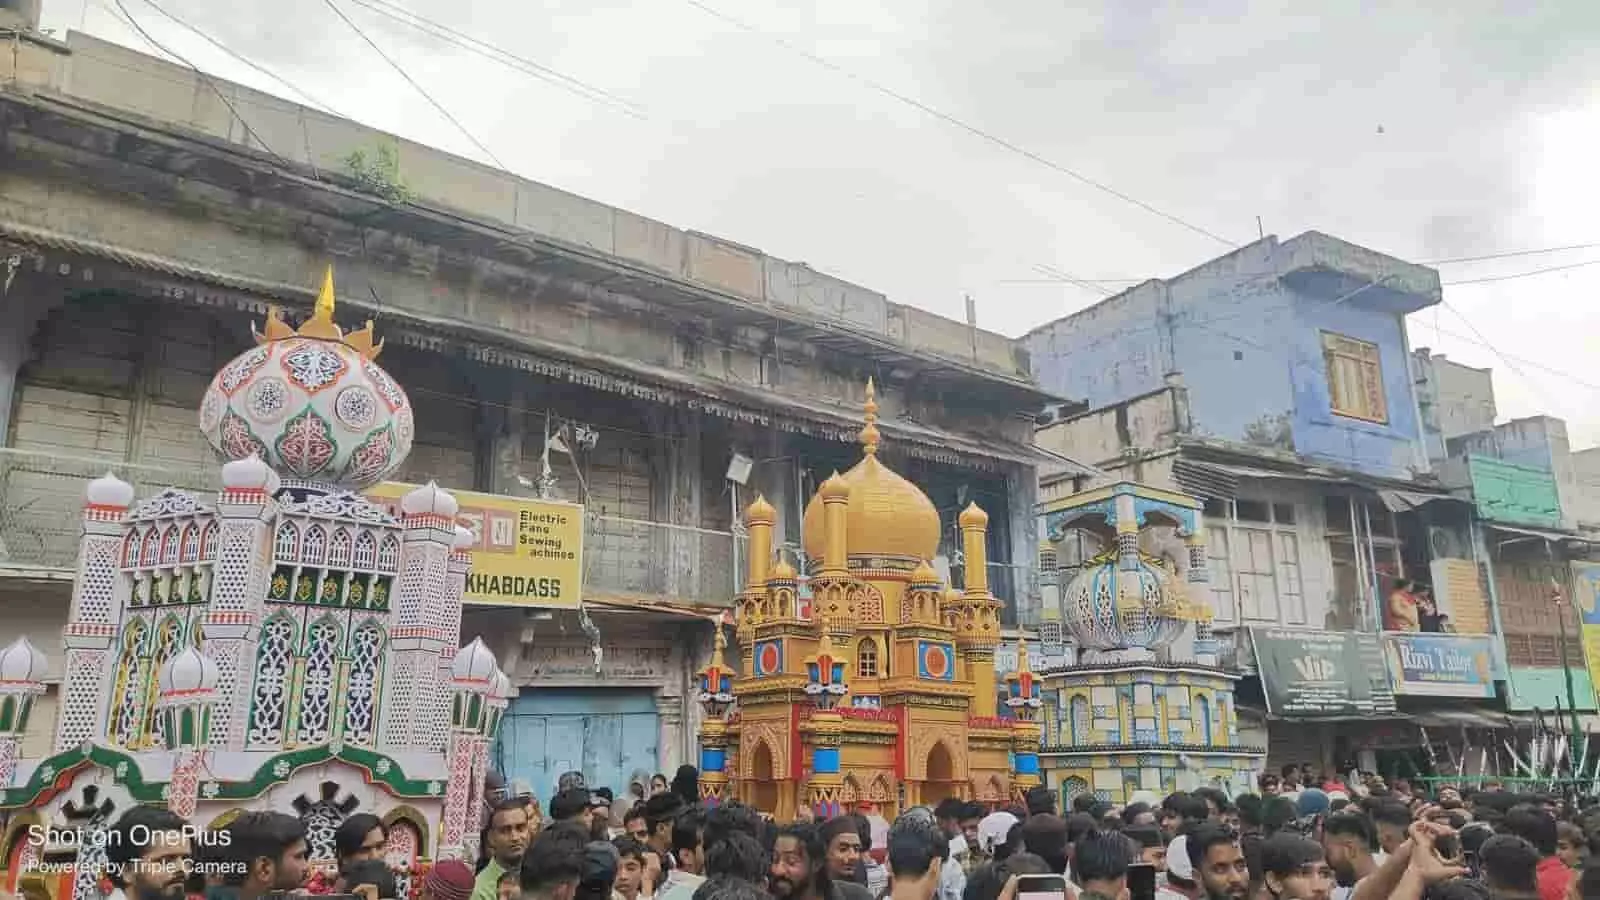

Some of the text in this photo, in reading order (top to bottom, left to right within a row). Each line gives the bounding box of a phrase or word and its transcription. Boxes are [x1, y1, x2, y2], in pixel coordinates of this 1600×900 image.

[519, 510, 567, 525] Electric
[519, 534, 562, 549] Sewing
[526, 549, 575, 560] achines
